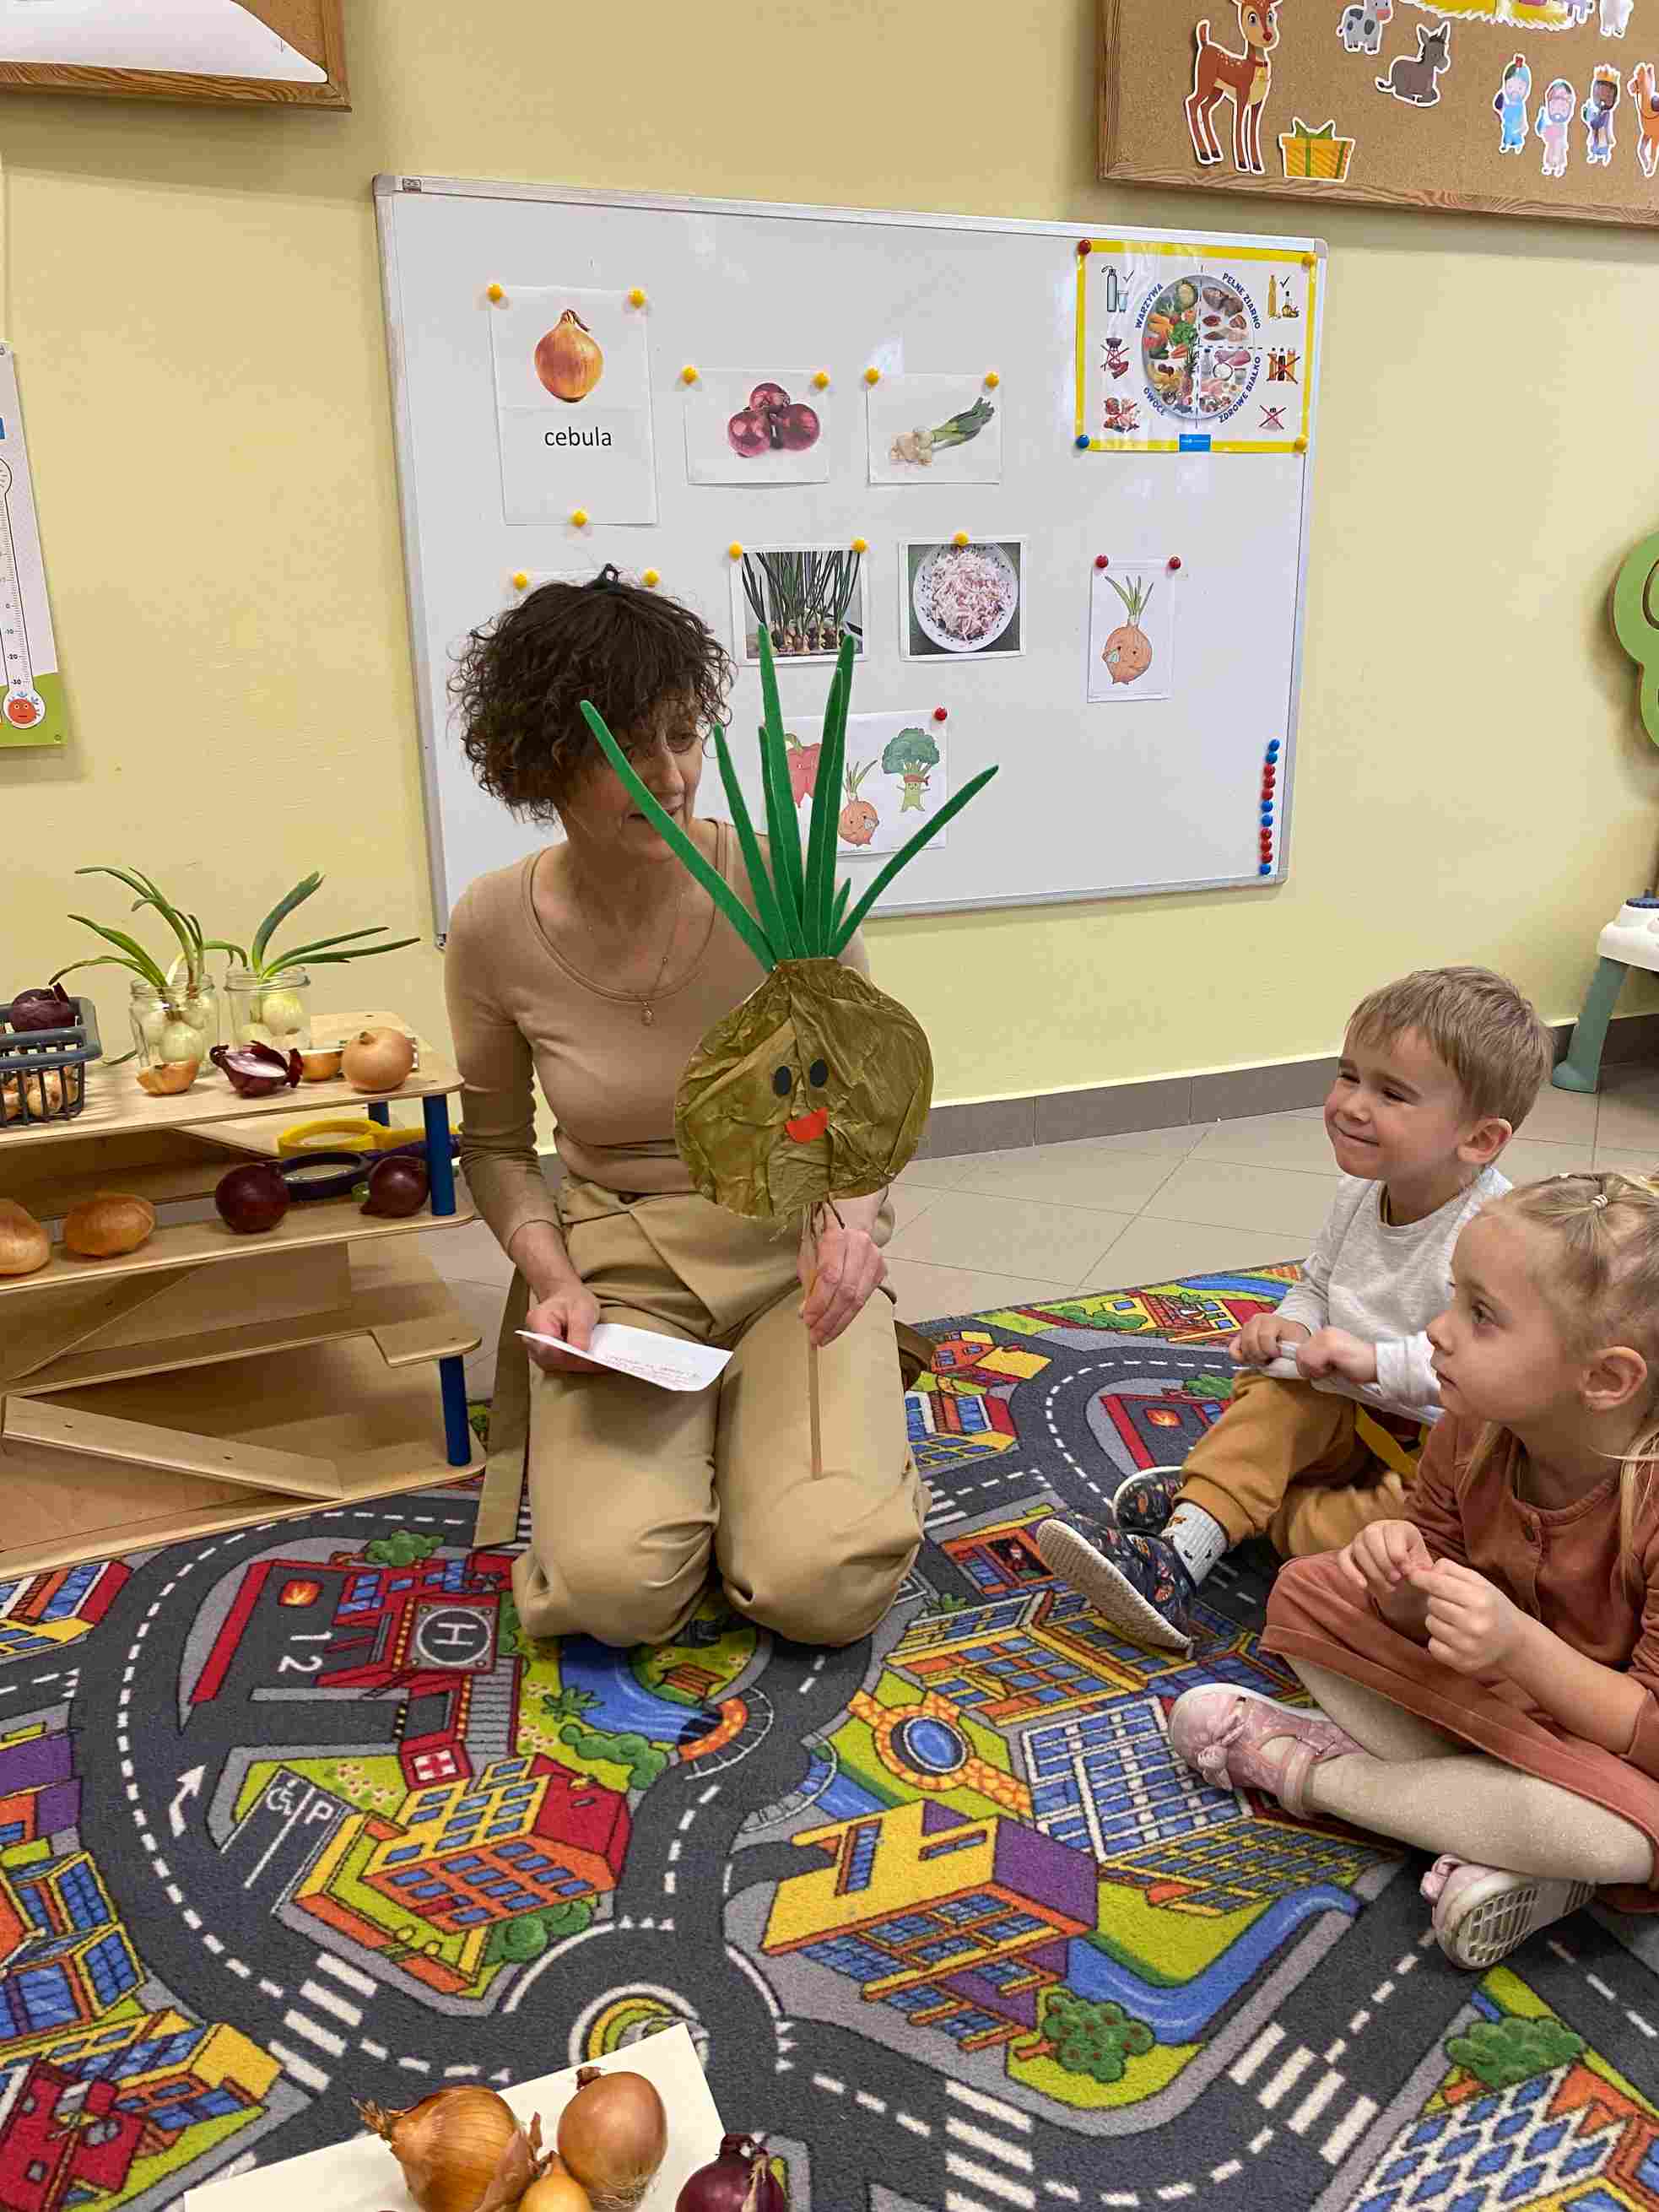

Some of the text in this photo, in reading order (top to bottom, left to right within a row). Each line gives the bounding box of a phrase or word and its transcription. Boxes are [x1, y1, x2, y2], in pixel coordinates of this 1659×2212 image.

[1135, 283, 1163, 328] WARZYWA
[1243, 294, 1261, 329] ZIARNO
[1219, 392, 1248, 423] ZDROWE
[544, 425, 612, 446] cebula
[431, 1622, 478, 1647] H
[304, 1800, 333, 1825] P
